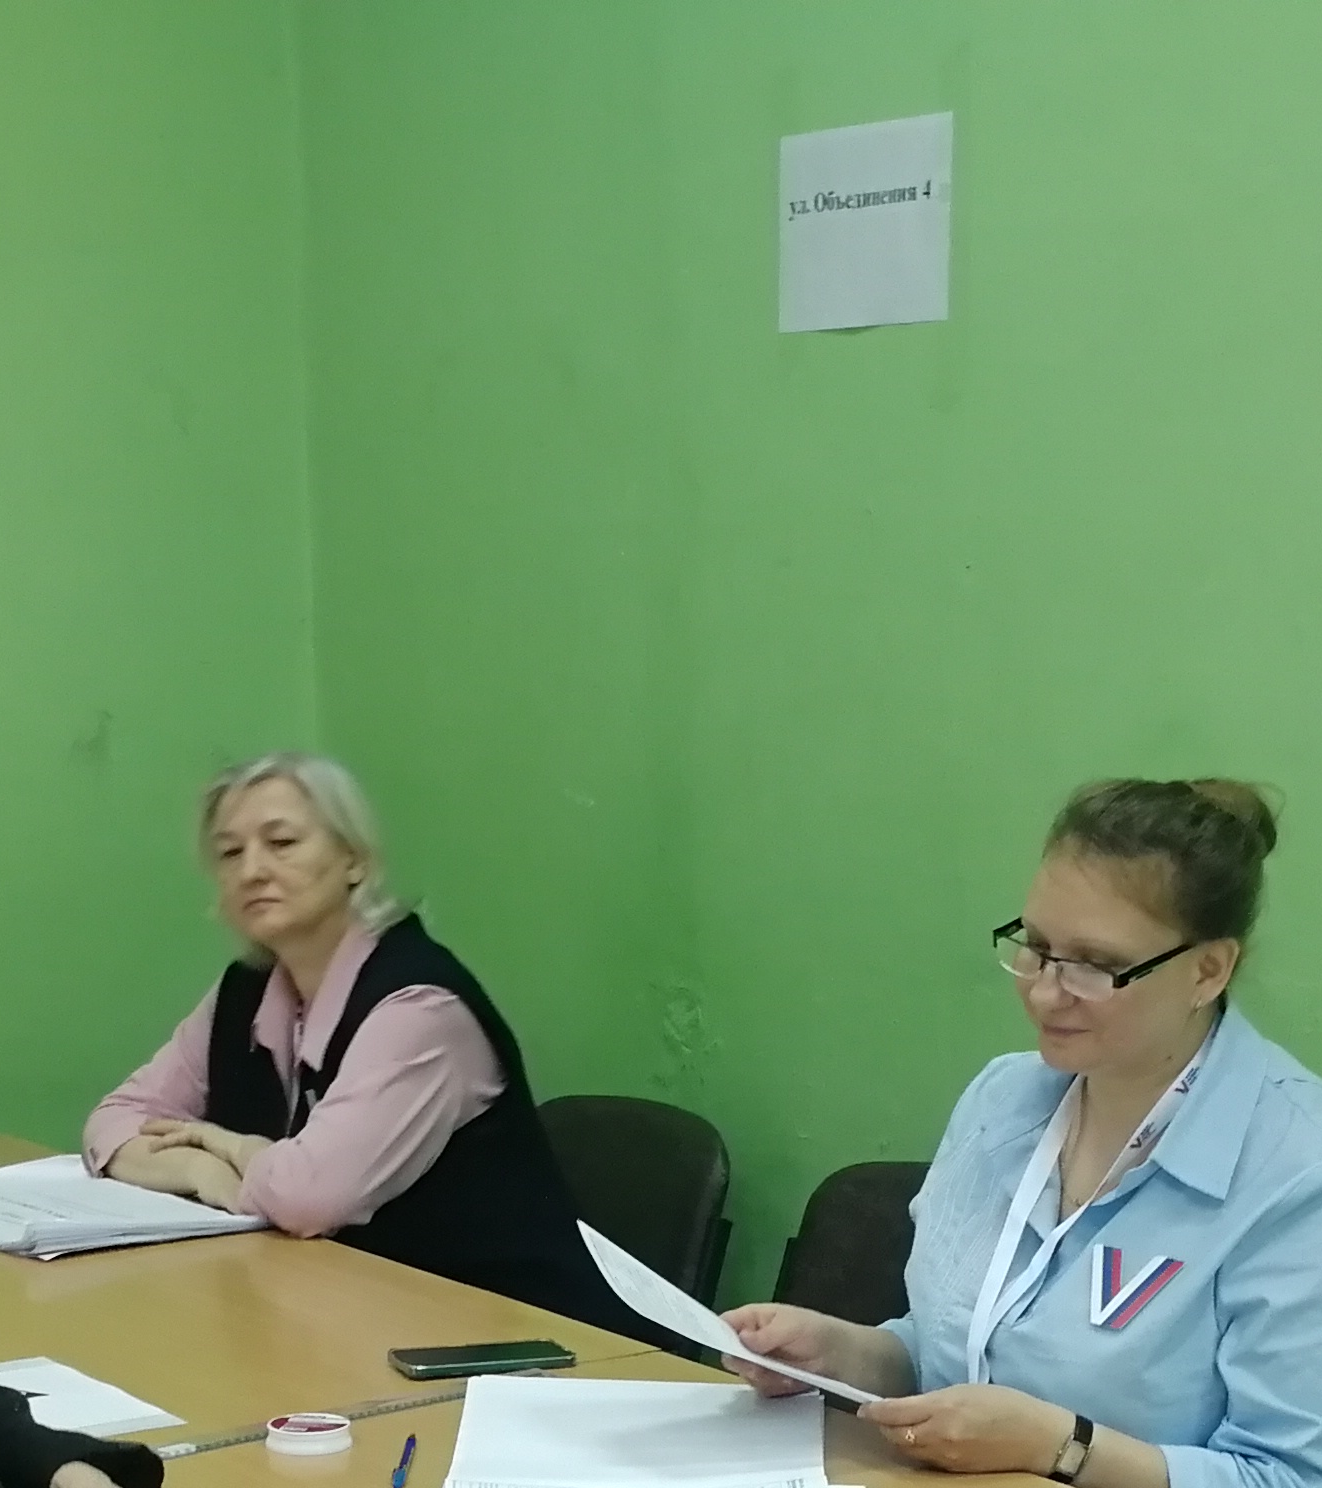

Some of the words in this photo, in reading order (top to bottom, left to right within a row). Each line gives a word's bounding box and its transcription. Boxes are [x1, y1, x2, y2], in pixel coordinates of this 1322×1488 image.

[788, 200, 812, 222] ул.
[814, 185, 918, 213] Объединения
[922, 179, 932, 199] 4
